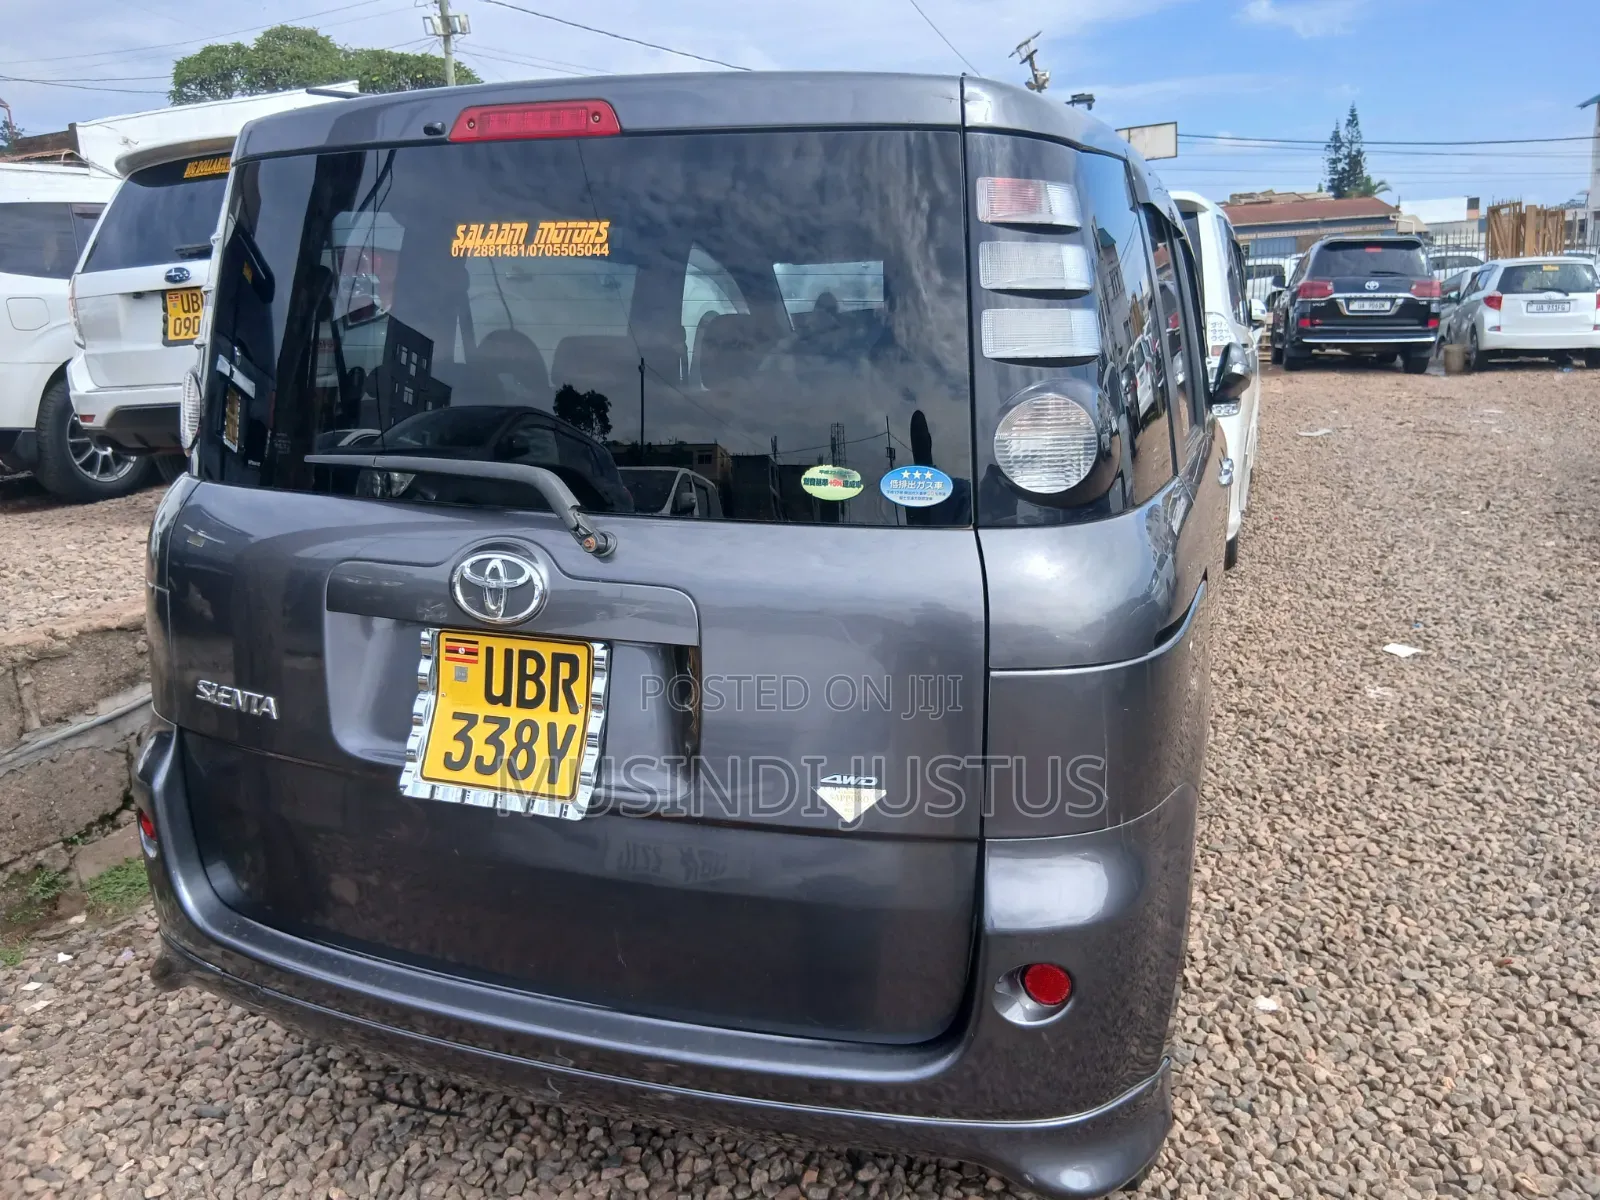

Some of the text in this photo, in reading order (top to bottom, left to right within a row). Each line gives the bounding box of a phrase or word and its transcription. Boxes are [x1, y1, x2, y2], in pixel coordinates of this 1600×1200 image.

[452, 221, 610, 246] SALAAM MOTORS
[451, 244, 610, 257] 0772881481/0705505044
[181, 290, 204, 314] UB
[889, 479, 944, 490] 低排出ガス車
[484, 645, 581, 716] UBR
[195, 679, 279, 720] SIENTA
[443, 711, 578, 785] 338Y
